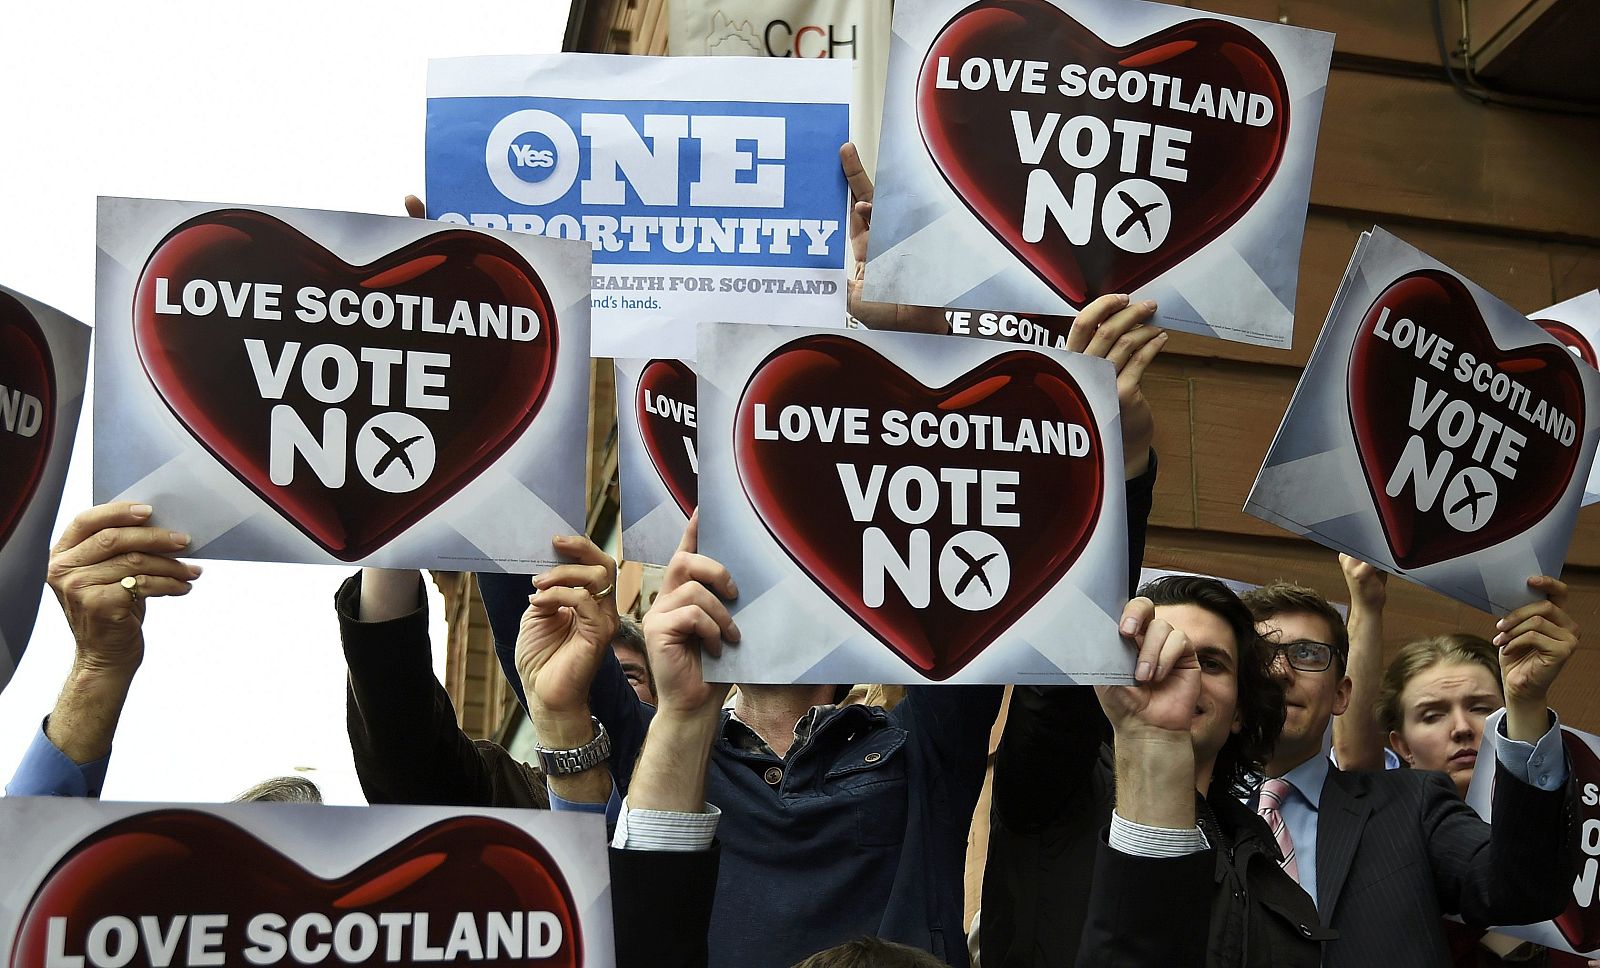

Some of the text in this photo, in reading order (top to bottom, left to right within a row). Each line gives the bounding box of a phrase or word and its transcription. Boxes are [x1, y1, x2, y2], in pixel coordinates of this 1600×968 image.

[935, 56, 1274, 128] LOVE SCOTLAND
[485, 109, 786, 209] ONE
[510, 143, 554, 169] Yes
[1010, 109, 1193, 183] VOTE
[1021, 168, 1172, 254] NO
[155, 277, 541, 342] LOVE SCOTLAND
[621, 295, 662, 310] hands.
[669, 276, 715, 292] FOR
[719, 278, 837, 295] SCOTLAND
[243, 338, 451, 411] VOTE
[644, 384, 698, 429] LOVE
[1372, 306, 1577, 448] LOVE SCOTLAND
[269, 404, 436, 494] NO
[753, 403, 1090, 458] LOVE SCOTLAND
[1408, 376, 1528, 480] VOTE
[835, 462, 1021, 528] VOTE
[1385, 434, 1502, 533] NO
[862, 526, 1011, 612] NO
[45, 911, 563, 968] LOVE SCOTLAND
